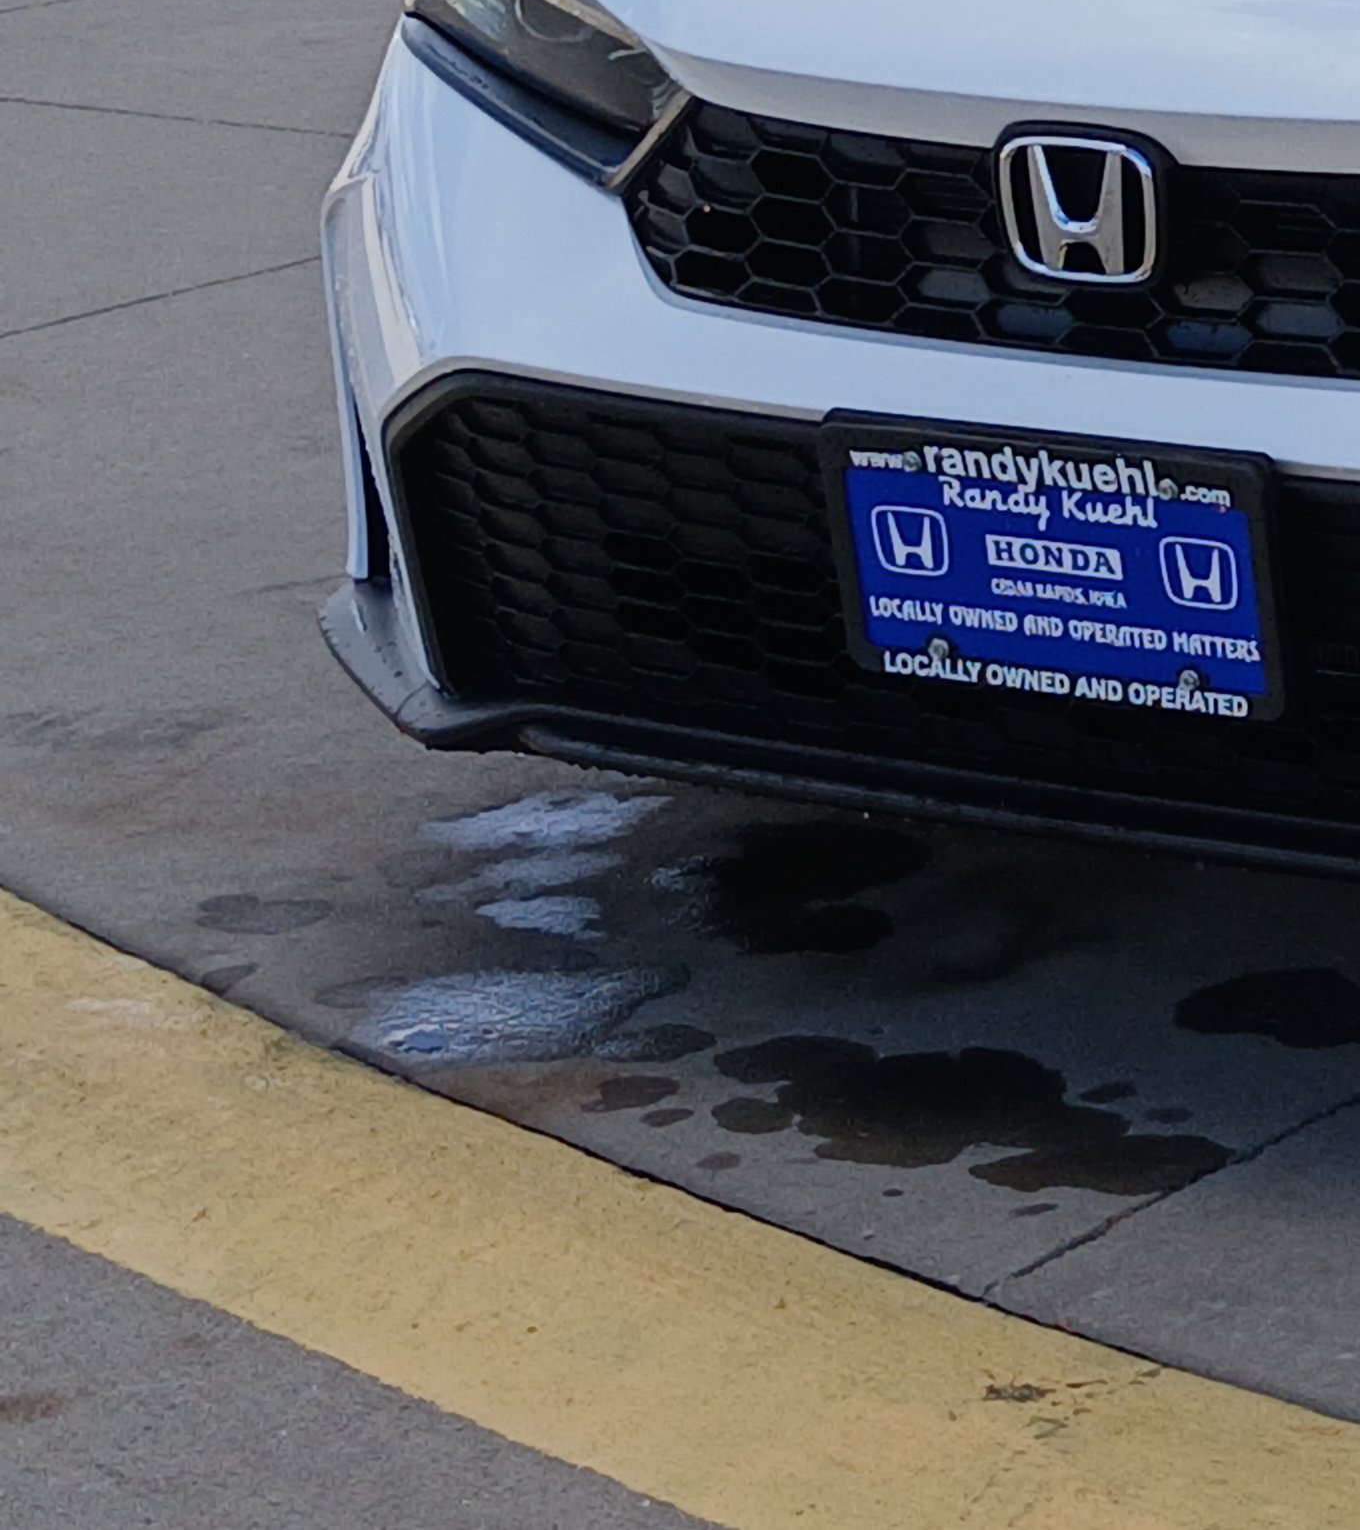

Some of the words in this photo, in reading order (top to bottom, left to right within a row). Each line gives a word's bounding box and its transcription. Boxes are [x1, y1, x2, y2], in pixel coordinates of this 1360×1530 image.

[938, 475, 1050, 531] Randy
[1062, 490, 1158, 529] Kuehl
[992, 539, 1116, 575] HONDA
[869, 595, 944, 625] LOCALLY
[949, 605, 1018, 632] OWNED
[1023, 614, 1064, 637] AND
[1068, 619, 1167, 650] OPERATED
[1172, 631, 1260, 662] MATTERS
[884, 650, 982, 683] LOCALLY
[985, 662, 1070, 695] OWNED
[1075, 676, 1123, 702] AND
[1128, 682, 1248, 717] OPERATED
